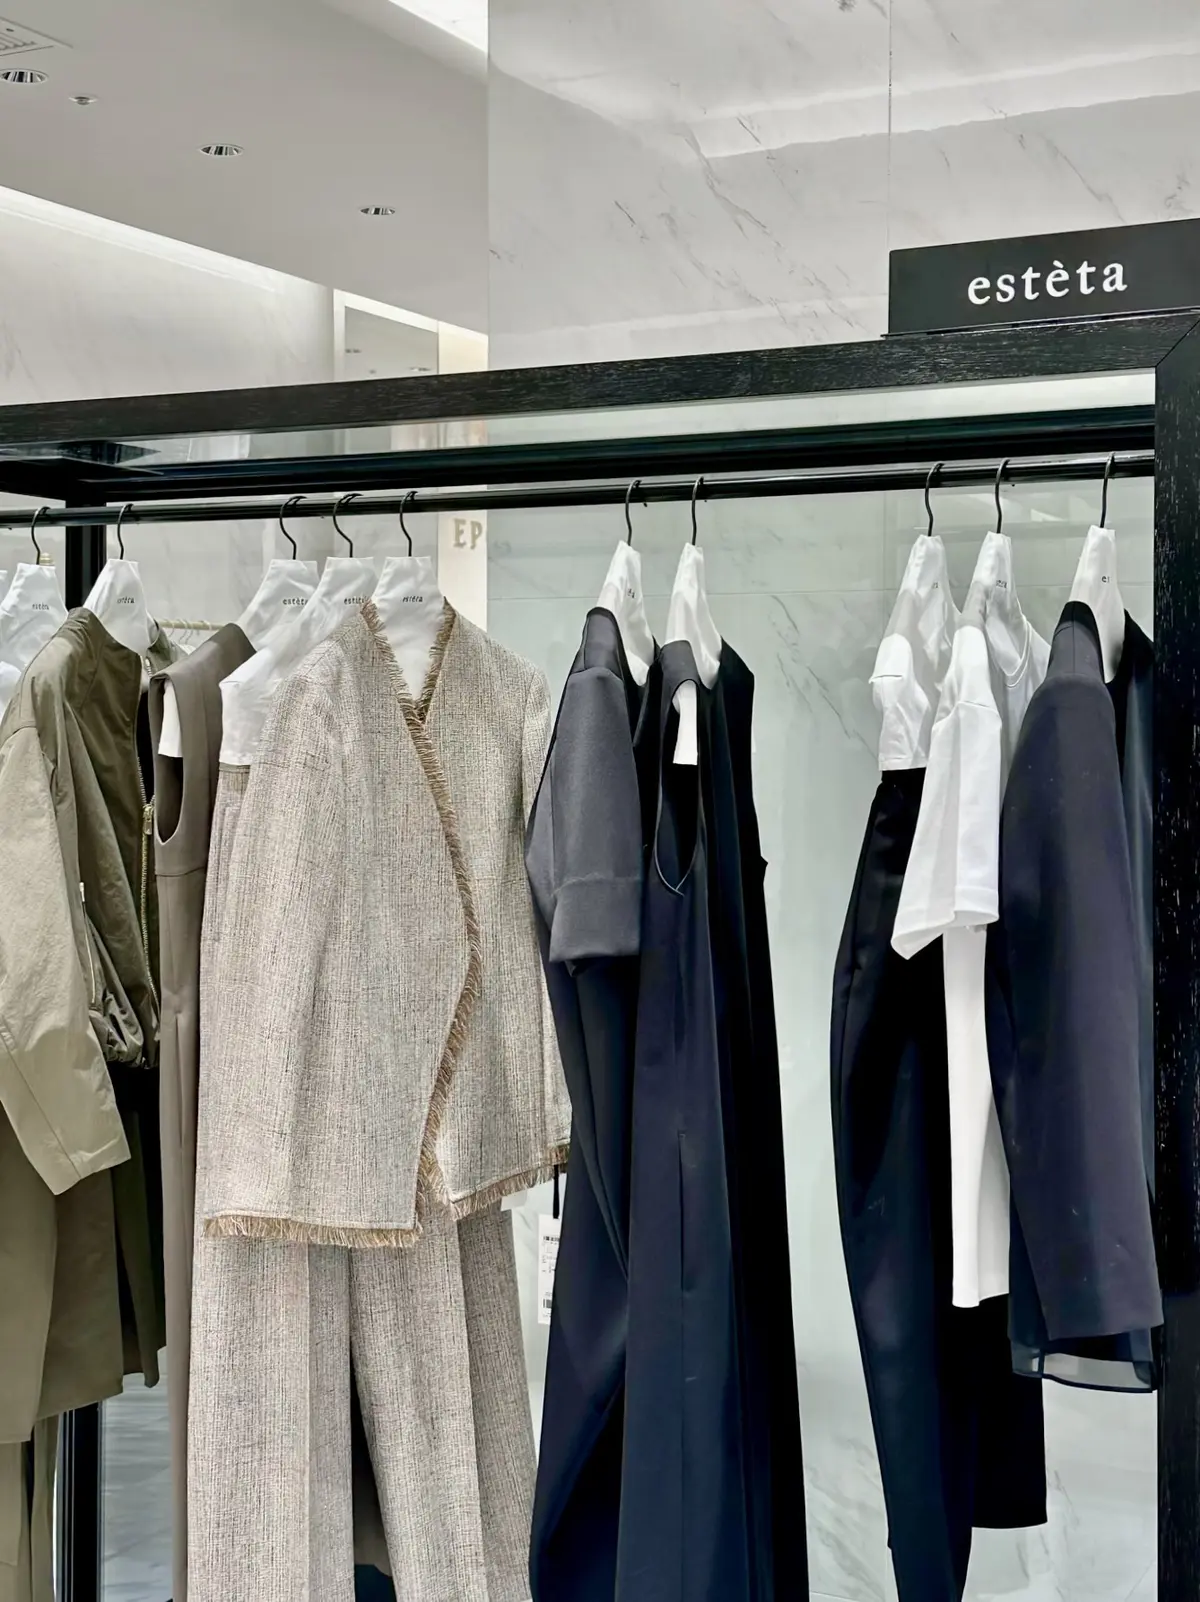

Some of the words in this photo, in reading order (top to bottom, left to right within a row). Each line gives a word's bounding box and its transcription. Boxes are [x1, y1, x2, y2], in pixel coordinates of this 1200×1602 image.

[968, 260, 1128, 305] estèta
[453, 517, 483, 550] EP
[282, 597, 308, 606] estèt
